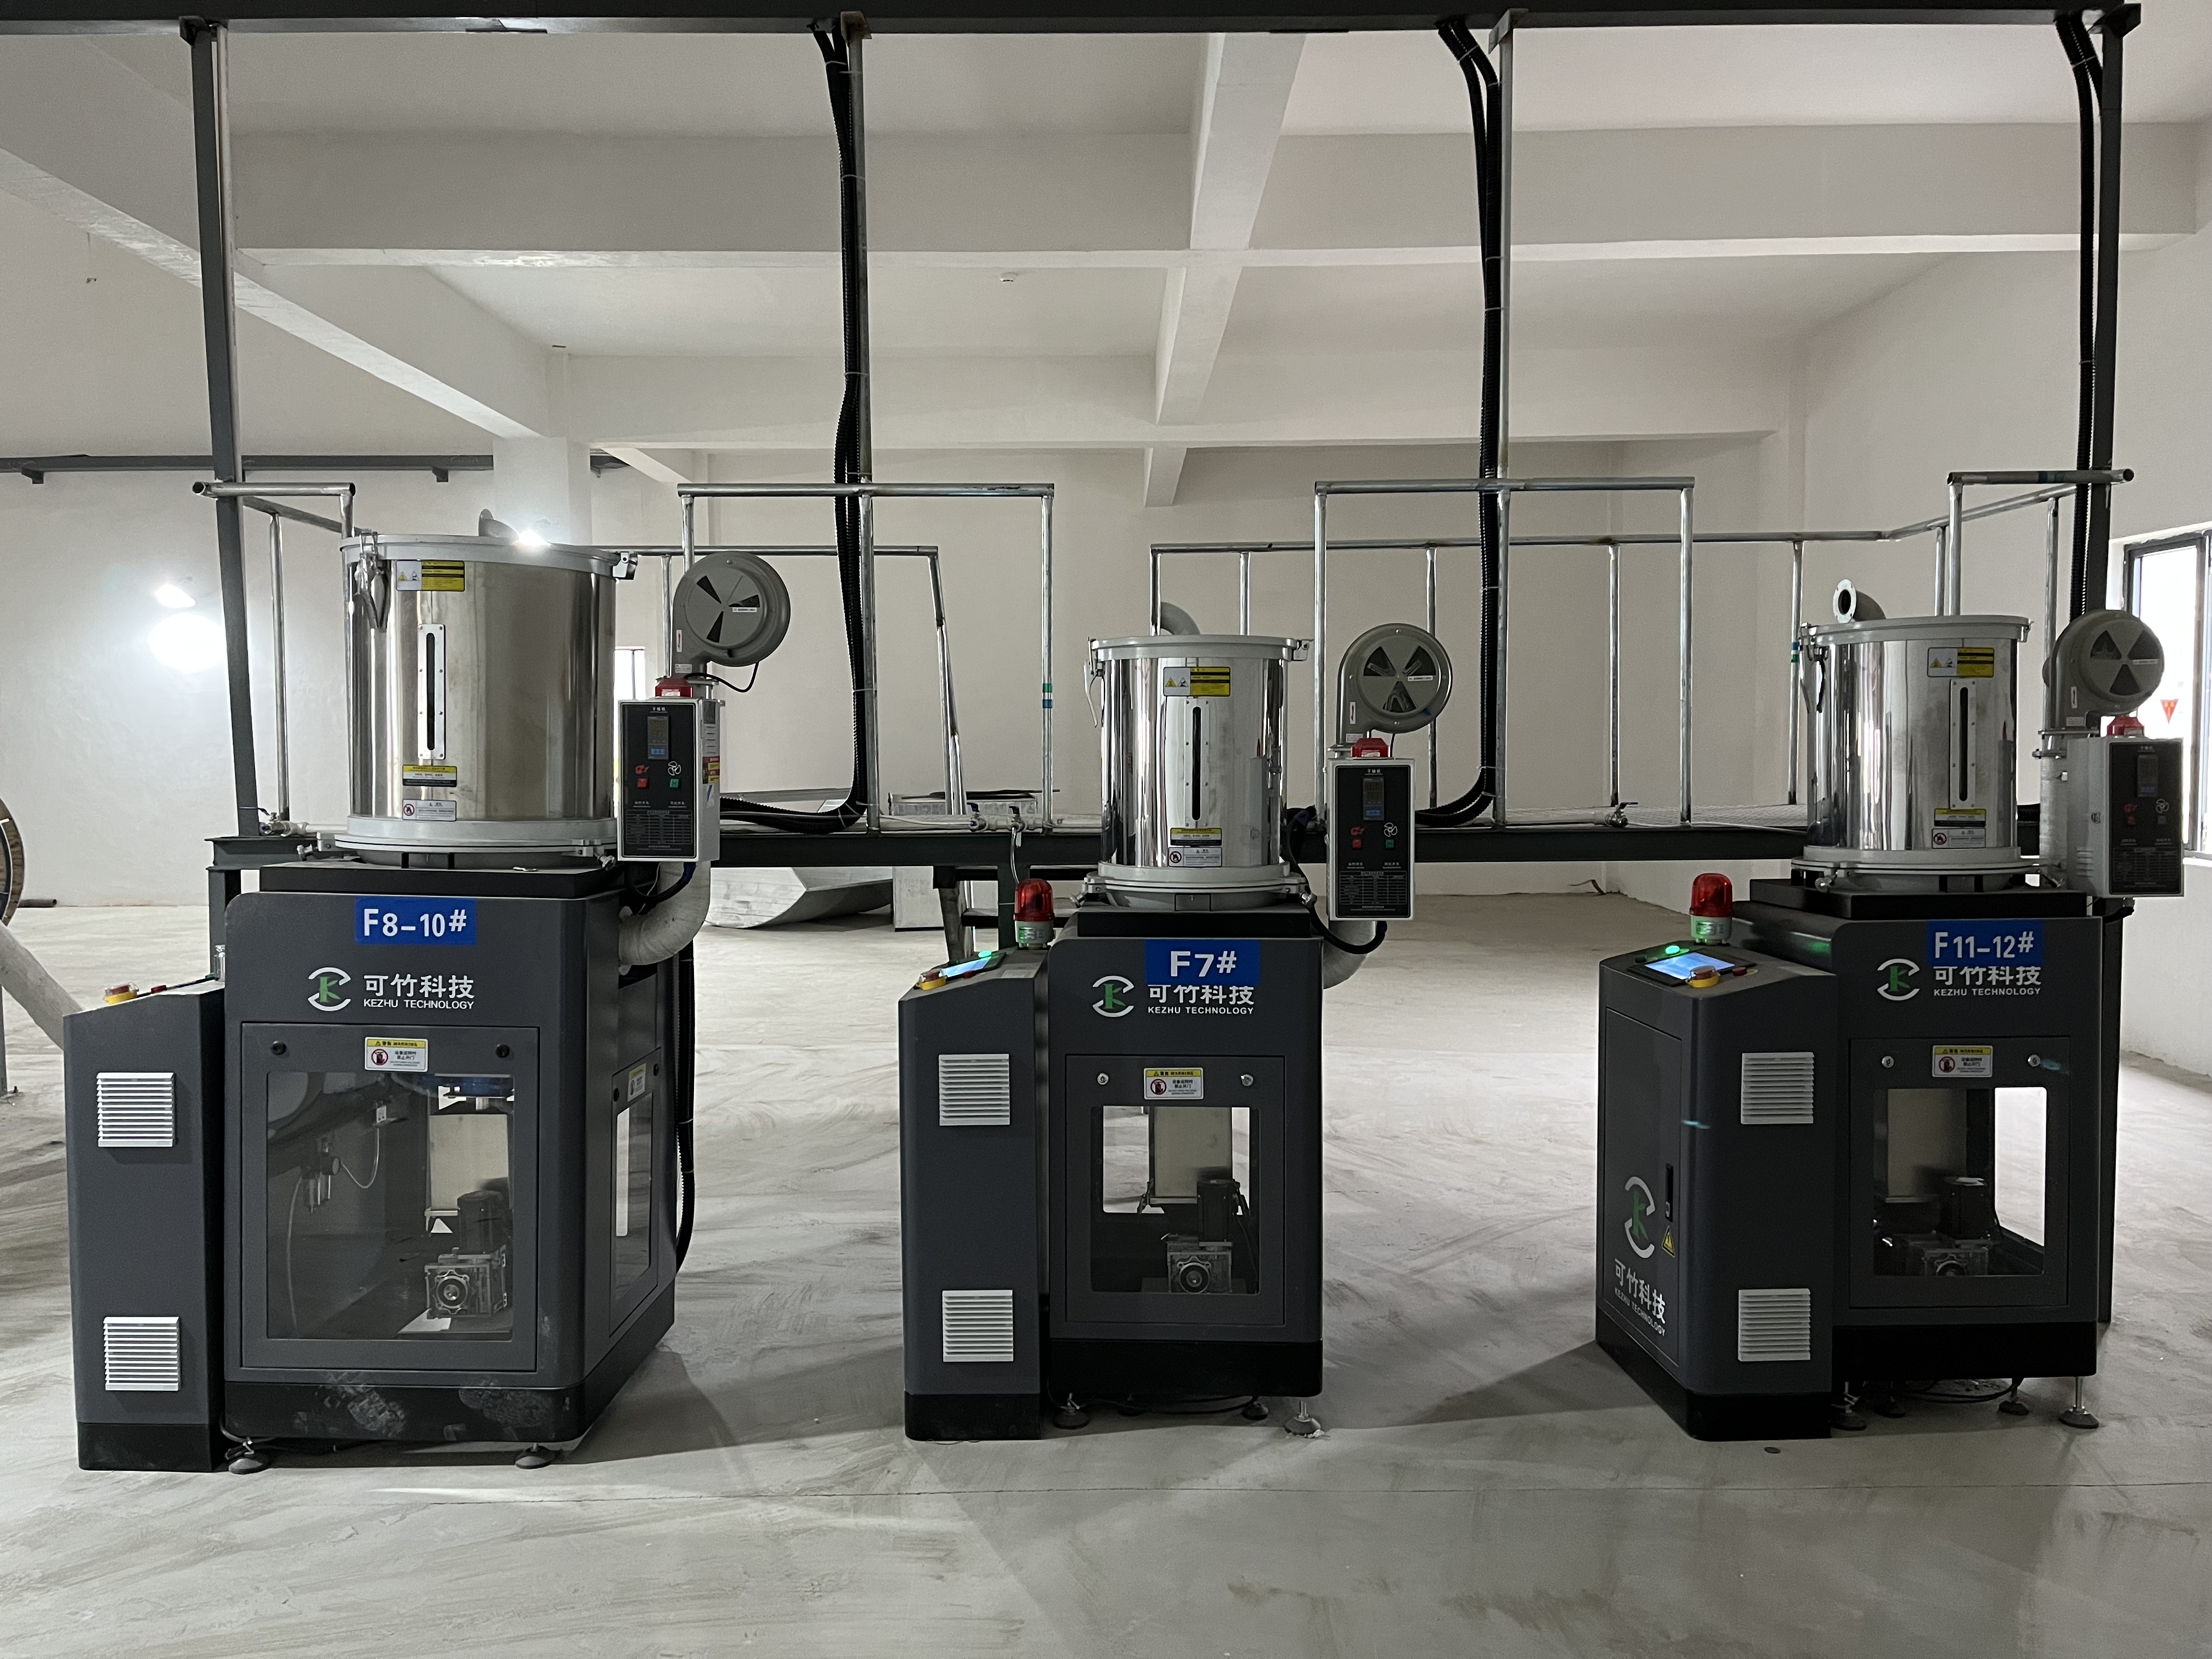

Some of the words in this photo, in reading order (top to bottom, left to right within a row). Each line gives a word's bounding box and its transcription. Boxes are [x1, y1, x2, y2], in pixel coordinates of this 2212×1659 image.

[364, 909, 467, 937] F8-10#
[1935, 931, 2034, 958] F11-12#
[1170, 950, 1237, 977] F7#
[1933, 966, 2042, 986] 可竹科技
[363, 973, 475, 999] 可竹科技
[1147, 984, 1255, 1006] 可竹科技
[1933, 988, 1967, 996] KEZHU
[1972, 988, 2041, 996] TECHNOLOGY
[363, 999, 399, 1008] KEZHU
[403, 1000, 475, 1009] TECHNOLOGY
[1147, 1006, 1181, 1014] KEZHU
[1185, 1007, 1254, 1015] TECHNOLOGY
[1615, 1258, 1666, 1324] 可竹科技
[1614, 1287, 1630, 1307] KEZHU
[1631, 1301, 1666, 1337] TECHNOLOGY
